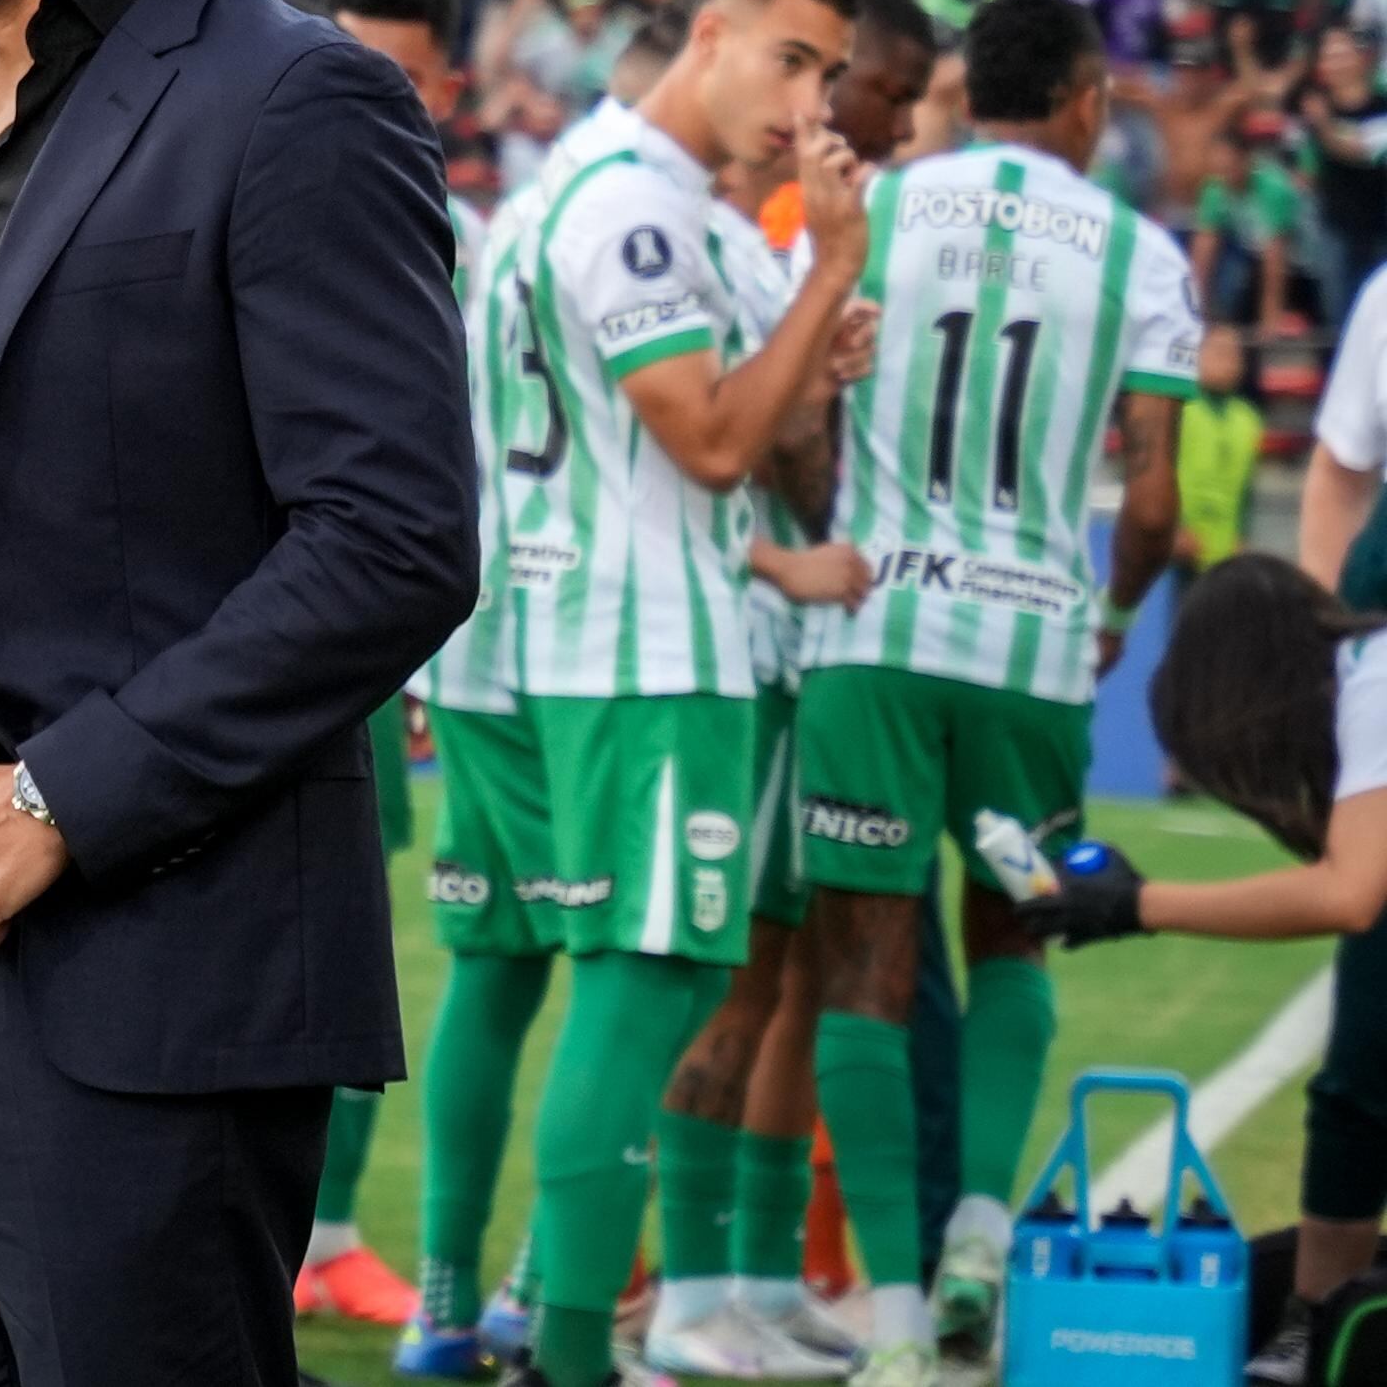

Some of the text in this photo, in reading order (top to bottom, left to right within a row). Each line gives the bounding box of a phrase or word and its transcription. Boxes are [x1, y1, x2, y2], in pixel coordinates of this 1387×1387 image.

[900, 188, 1105, 260] POSTOBON
[928, 311, 1041, 511] 11
[871, 549, 956, 592] JFK
[805, 803, 910, 847] NICO
